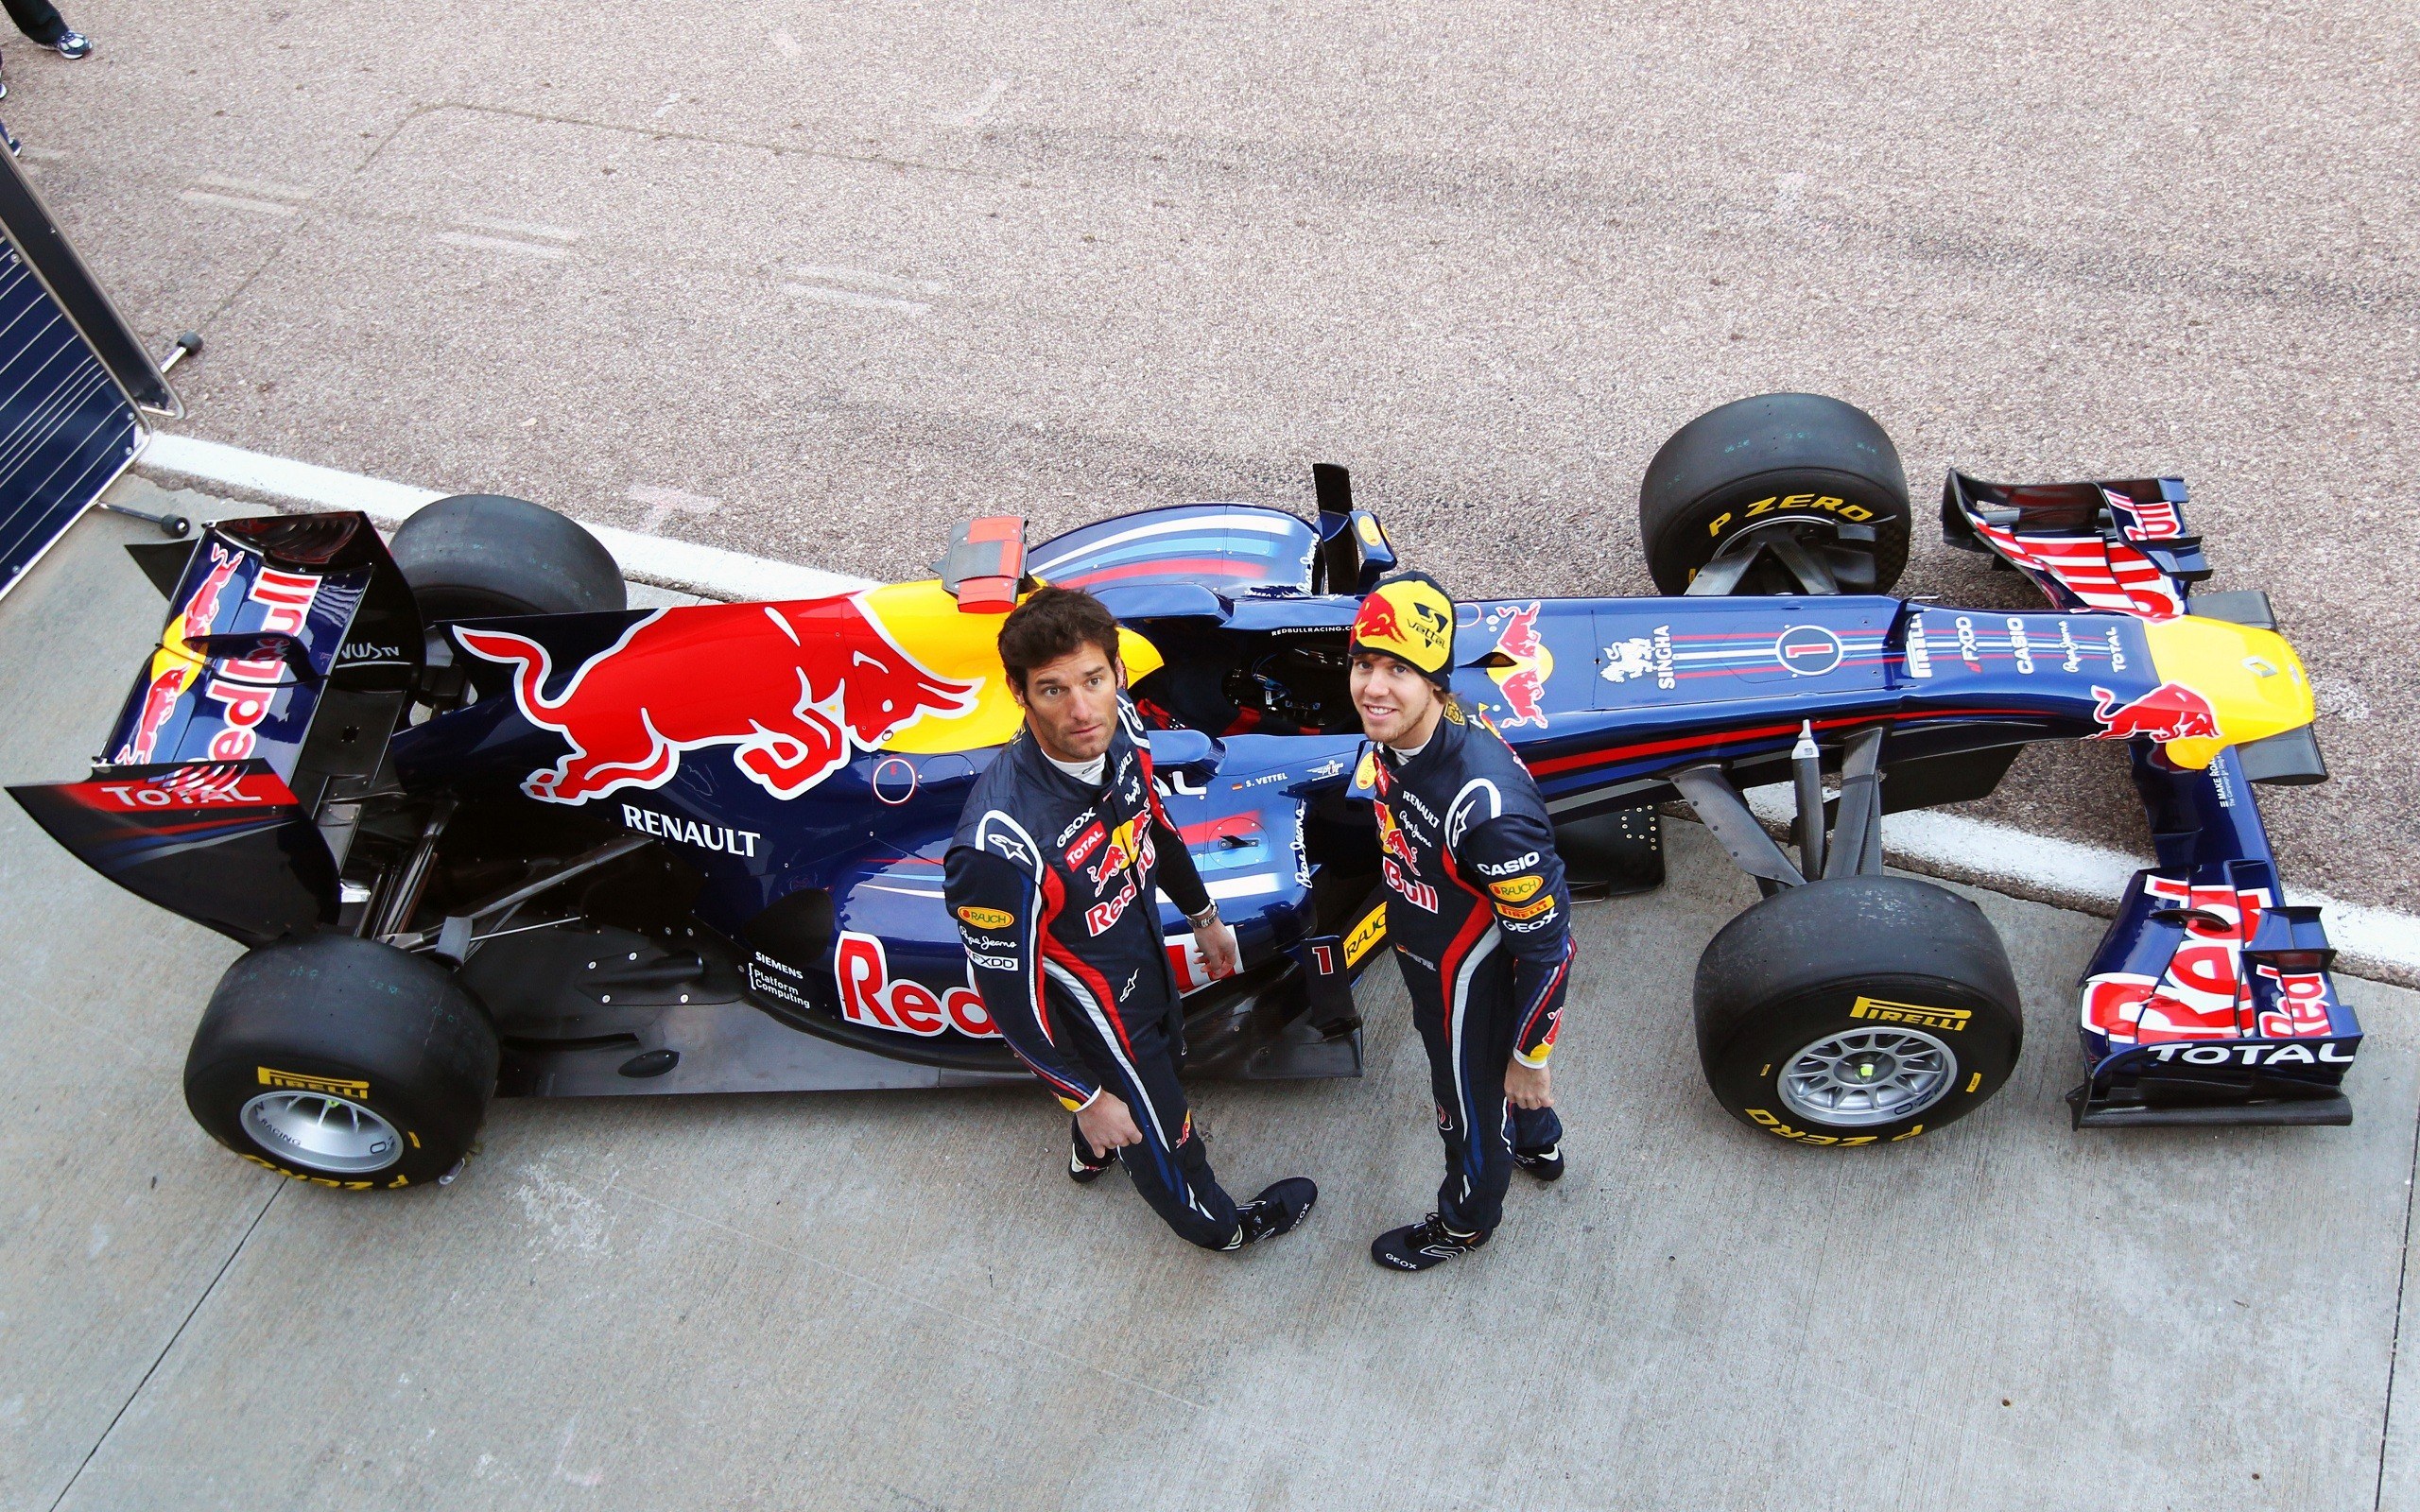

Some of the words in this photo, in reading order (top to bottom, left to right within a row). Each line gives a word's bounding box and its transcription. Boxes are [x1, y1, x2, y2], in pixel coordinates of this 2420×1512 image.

[1709, 512, 1732, 537] P
[1745, 493, 1874, 522] ZERO
[1270, 626, 1355, 637] REDBULLRACING.C
[1955, 616, 1979, 662] FXDD
[2006, 617, 2034, 674] CASIO
[1652, 625, 1676, 690] SINGHA
[1784, 643, 1834, 659] 1
[2105, 627, 2127, 673] TOTAL
[205, 678, 278, 762] ed
[1255, 772, 1288, 785] VETTEL
[2208, 756, 2221, 777] ROA
[101, 785, 262, 808] TOTAL
[2212, 777, 2227, 800] MAKE
[1402, 790, 1441, 829] RENAULT
[621, 803, 761, 858] RENAULT
[1056, 806, 1097, 849] GEOX
[1065, 830, 1105, 866] TOTAL
[1477, 850, 1541, 876] CASIO
[1382, 855, 1439, 915] Bull
[1500, 879, 1537, 897] RAUCH
[1084, 868, 1137, 937] Red
[1500, 899, 1548, 919] PIRELLI
[971, 911, 1007, 925] RAUCH
[1502, 906, 1560, 934] GEOX
[1346, 912, 1387, 960] RAUC
[755, 951, 804, 979] SIEMENS
[972, 953, 1014, 969] FXDD
[1311, 945, 1335, 976] 1
[753, 969, 799, 995] Platform
[755, 978, 811, 1009] Computing
[1849, 995, 1972, 1032] PIRELLI
[2147, 1042, 2355, 1066] TOTAL
[260, 1118, 302, 1146] RACING
[1385, 1252, 1417, 1270] GEOX
